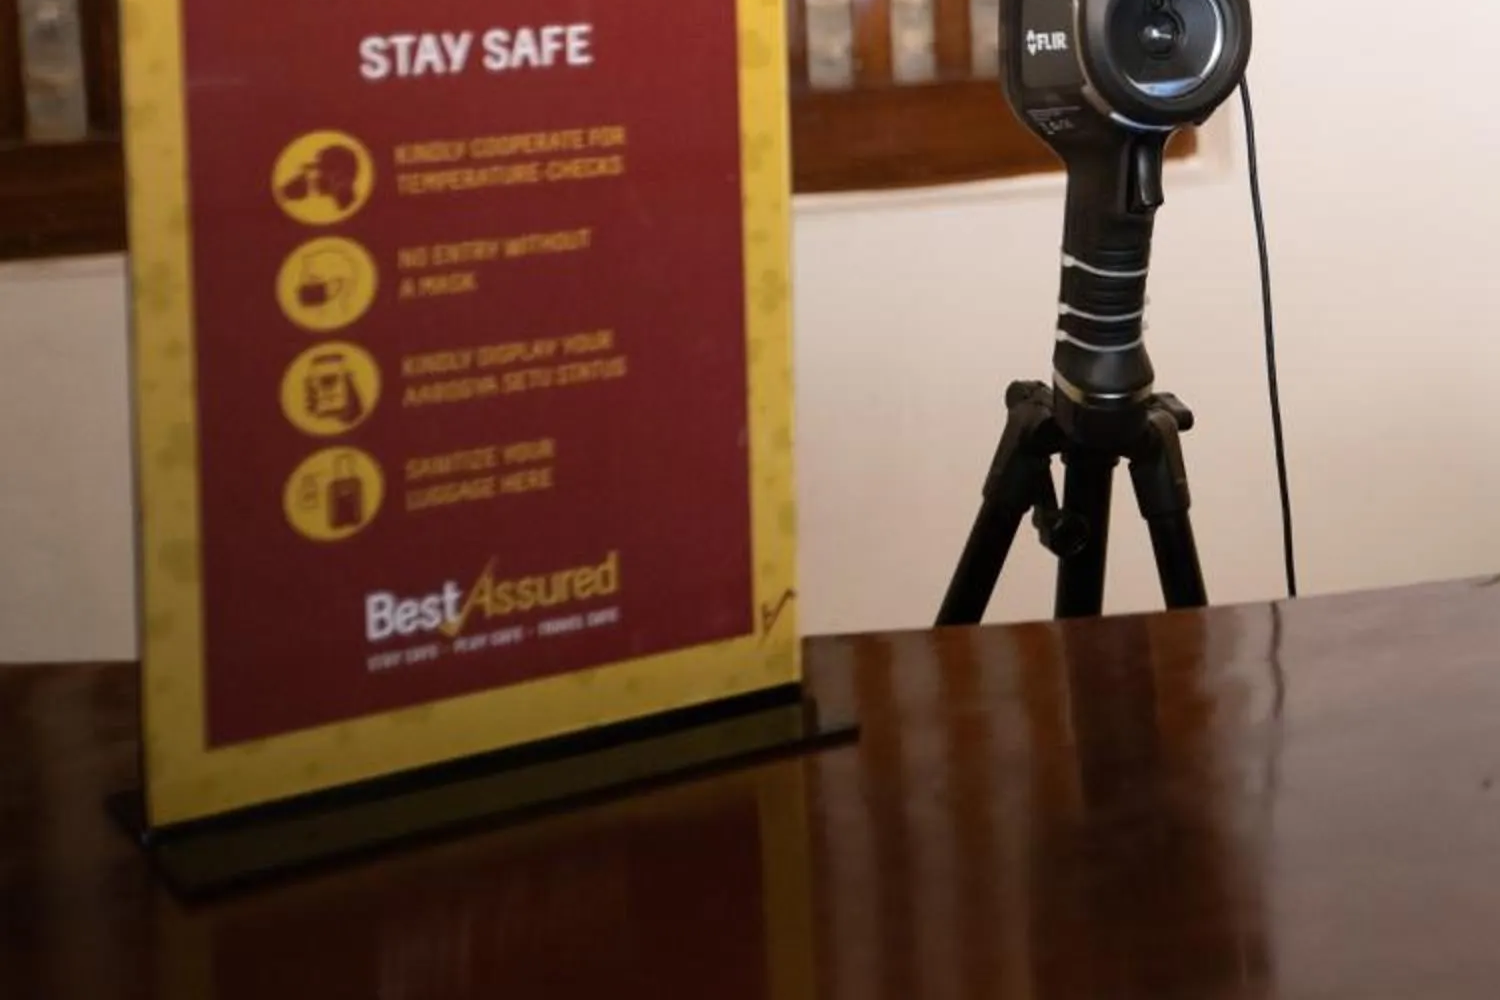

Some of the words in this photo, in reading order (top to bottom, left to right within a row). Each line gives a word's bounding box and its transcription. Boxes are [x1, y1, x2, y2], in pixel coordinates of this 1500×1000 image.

[358, 32, 473, 79] STAY
[481, 22, 594, 71] SAFE
[1036, 31, 1069, 51] FLIR
[394, 140, 466, 165] KINDLY
[468, 130, 586, 159] COOPERATE
[588, 125, 625, 147] FOR
[397, 162, 541, 194] TEMPERATURE
[545, 155, 624, 182] CHECKS
[397, 246, 428, 269] NO
[431, 240, 500, 266] ENTRY
[504, 227, 593, 258] WITHOUT
[399, 276, 416, 298] A
[417, 272, 477, 297] MASK
[402, 350, 473, 376] KINDLY
[475, 338, 557, 368] DISPLAY
[560, 328, 614, 355] YOUR
[556, 355, 628, 386] STATUS
[405, 446, 497, 481] SANITIZE
[502, 437, 556, 465] YOUR
[405, 475, 496, 512] LUGGAGE
[500, 466, 554, 494] HERE
[364, 580, 463, 643] Best
[440, 549, 621, 636] Assured
